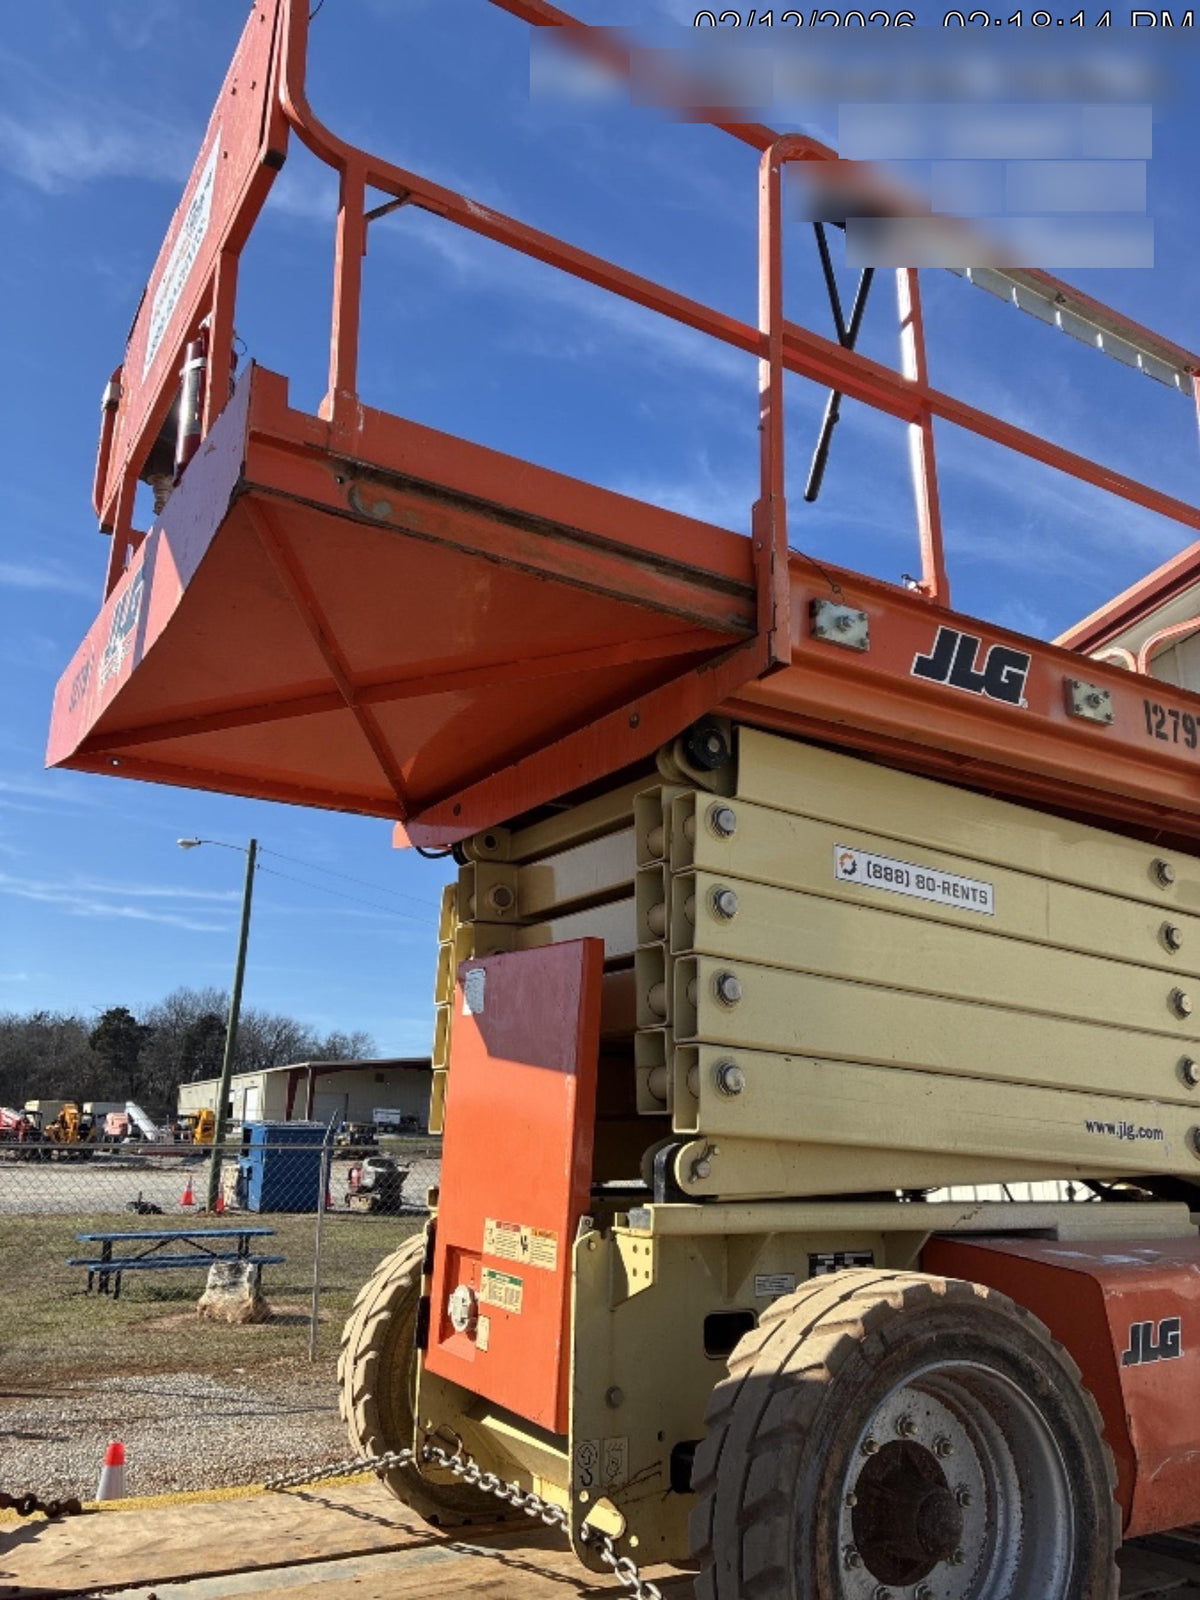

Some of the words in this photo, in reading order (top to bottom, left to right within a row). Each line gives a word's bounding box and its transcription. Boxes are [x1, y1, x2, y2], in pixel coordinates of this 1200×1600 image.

[910, 624, 1032, 707] JLG
[1143, 698, 1200, 749] 1279
[866, 860, 911, 888] (888)
[915, 874, 988, 905] 80-RENTS
[1085, 1119, 1164, 1141] www.jlg.com
[1120, 1315, 1184, 1368] JLG
